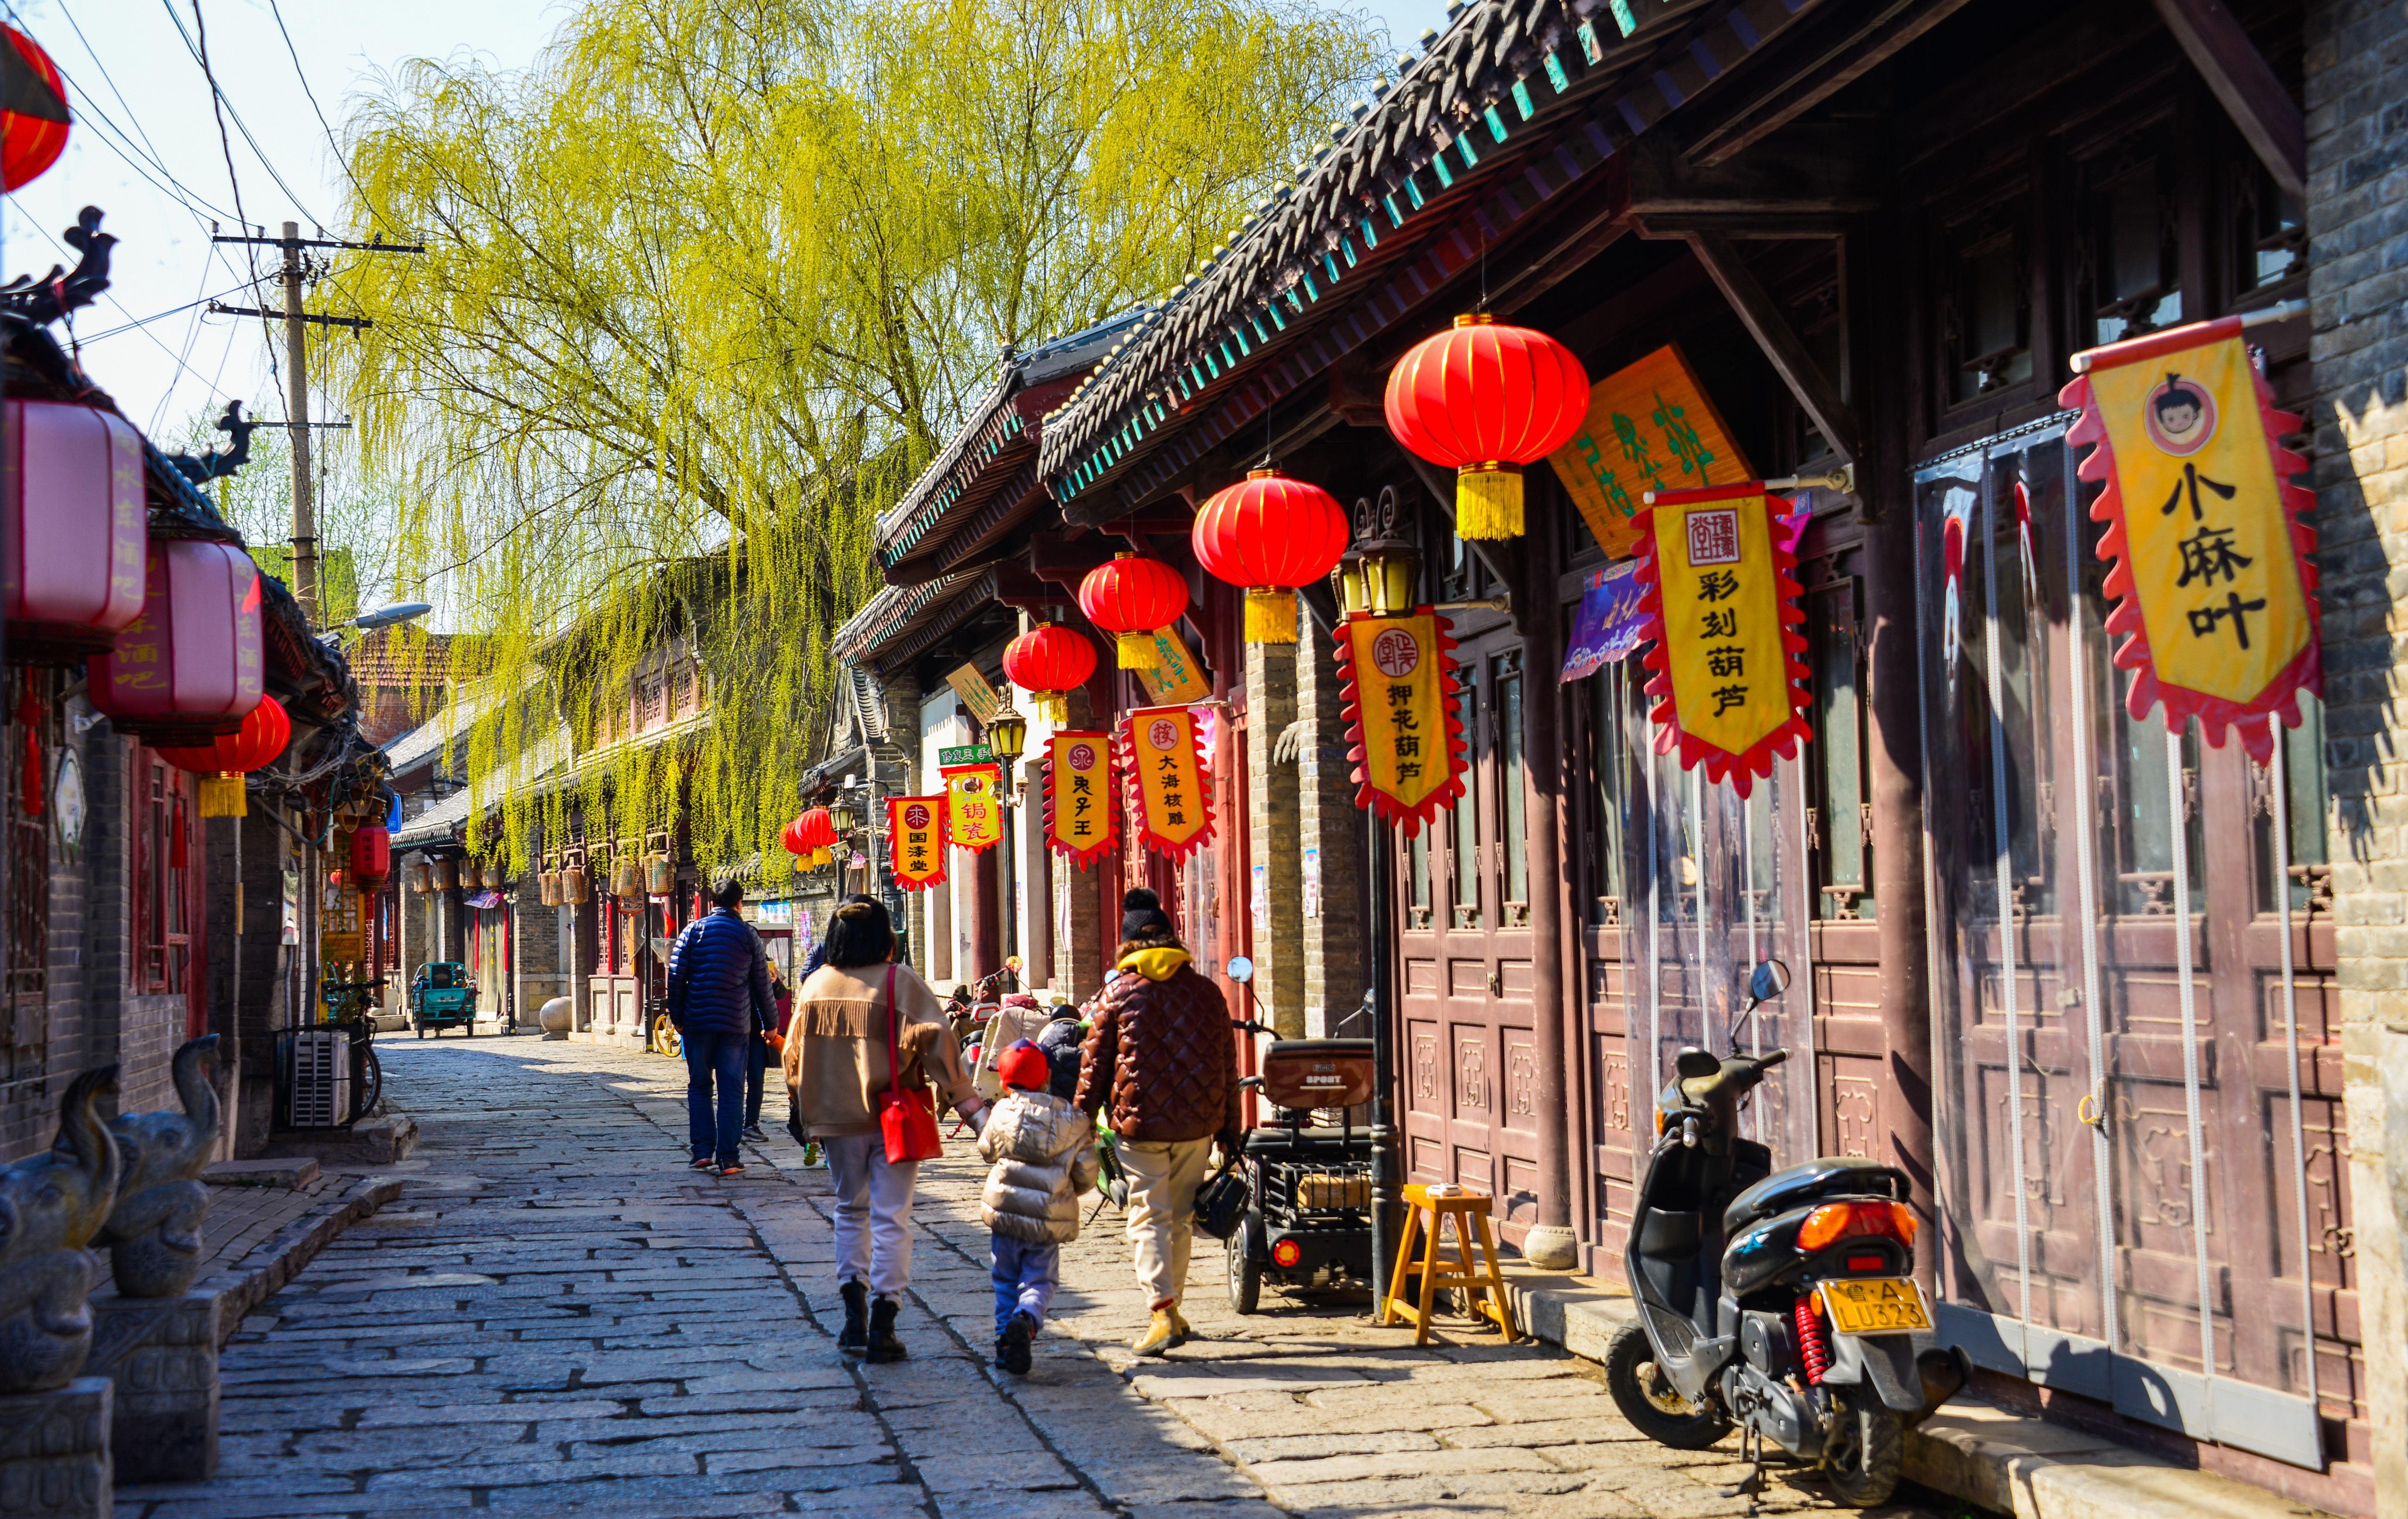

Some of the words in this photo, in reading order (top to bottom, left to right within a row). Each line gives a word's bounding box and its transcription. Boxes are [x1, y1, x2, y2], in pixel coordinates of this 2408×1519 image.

[2161, 463, 2266, 650] 小麻叶
[1697, 569, 1749, 718] 彩刻葫芦
[1386, 684, 1422, 785] 押花葫芦
[961, 802, 991, 840] 锔瓷
[1072, 775, 1094, 836] 兔子王
[1158, 755, 1186, 826] 大海核雕
[907, 832, 929, 872] 国漆堂
[1837, 1302, 1922, 1328] LU323
